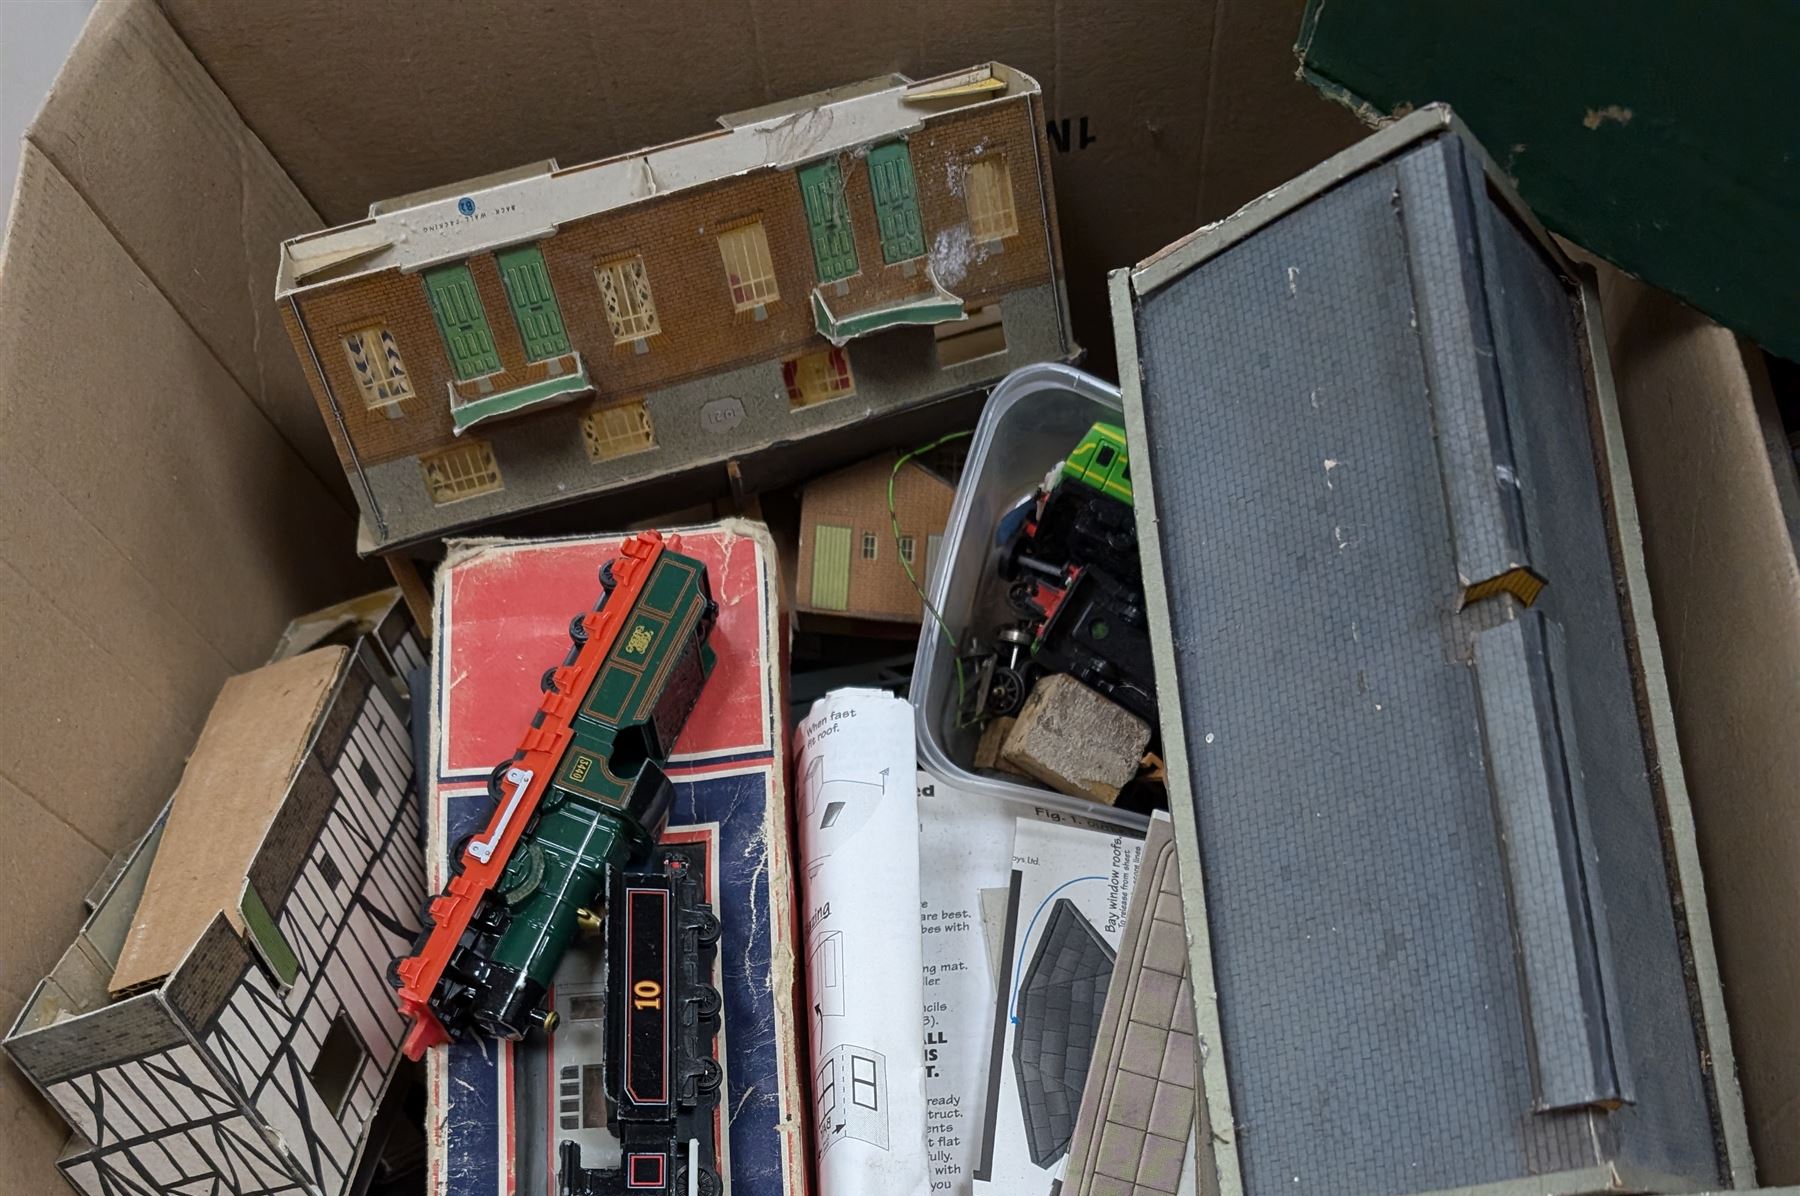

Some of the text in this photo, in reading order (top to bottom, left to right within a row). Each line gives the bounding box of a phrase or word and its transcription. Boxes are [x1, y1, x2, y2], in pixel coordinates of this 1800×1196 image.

[806, 709, 857, 738] When fast
[817, 722, 840, 741] roof.
[1034, 806, 1066, 822] Fig.
[1122, 849, 1131, 871] sheet
[1105, 836, 1122, 933] Bay window roofs.
[1120, 872, 1129, 891] from
[941, 909, 971, 920] best.
[944, 921, 970, 932] with
[940, 962, 968, 972] mat.
[634, 980, 661, 1010] 10
[924, 1031, 948, 1045] LL
[937, 1136, 961, 1147] flat
[935, 1163, 961, 1175] with
[930, 1181, 952, 1192] you
